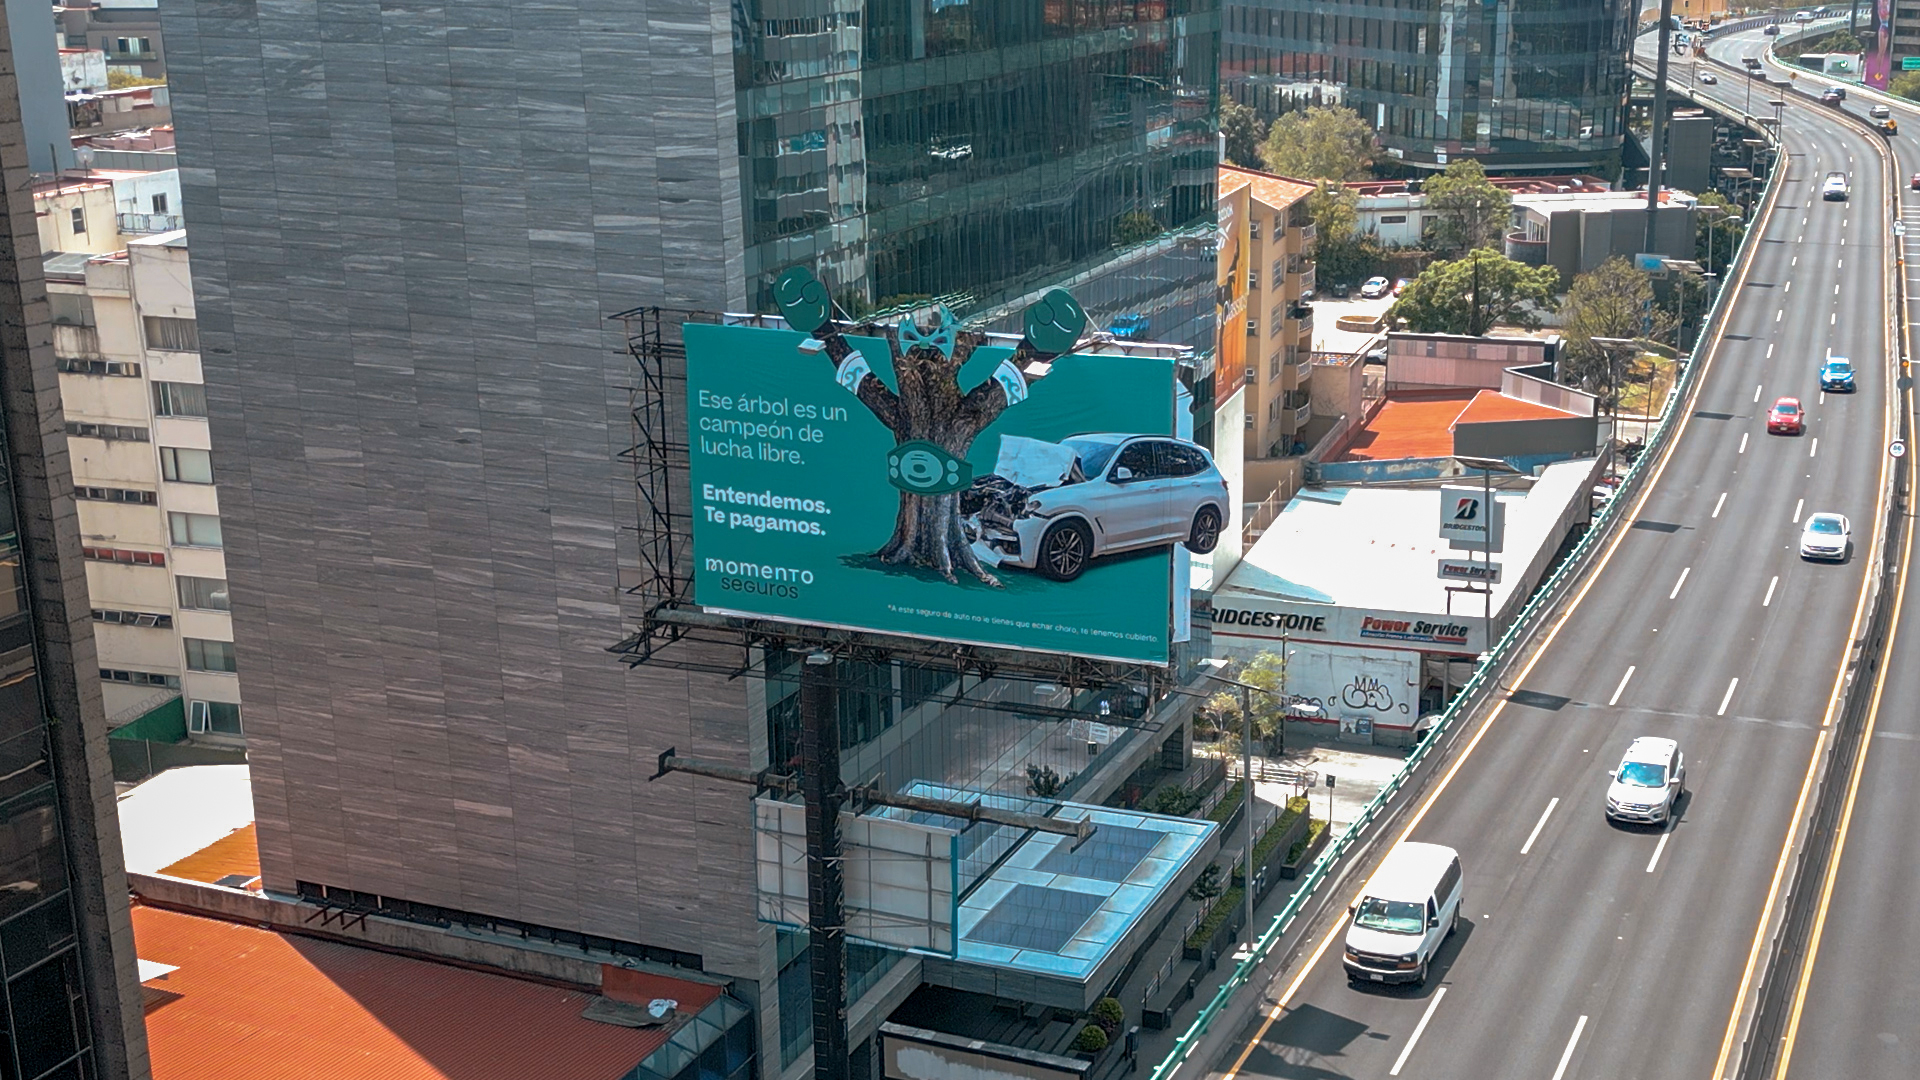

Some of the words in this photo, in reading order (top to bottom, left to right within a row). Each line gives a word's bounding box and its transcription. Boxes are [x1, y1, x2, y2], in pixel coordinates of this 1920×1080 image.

[699, 390, 732, 410] Ese
[738, 393, 788, 416] árbol
[794, 404, 816, 419] es
[822, 406, 848, 422] un
[699, 416, 793, 441] campeón
[799, 424, 824, 443] de
[700, 436, 753, 460] lucha
[759, 441, 806, 465] libre.
[703, 483, 831, 515] Entendemos.
[704, 505, 726, 523] Te
[730, 512, 826, 536] pagamos.
[1443, 523, 1487, 532] BRIDGESTON
[1470, 566, 1497, 577] Servce
[898, 606, 914, 614] este
[916, 608, 941, 617] seguro
[942, 611, 952, 619] de
[953, 612, 970, 620] auto
[991, 617, 1014, 626] tienes
[1031, 621, 1053, 631] echar
[1080, 627, 1089, 635] te
[1090, 628, 1124, 639] tenemos
[1211, 607, 1326, 632] RIDGESTONE
[1361, 616, 1411, 633] Power
[1413, 620, 1468, 637] Service
